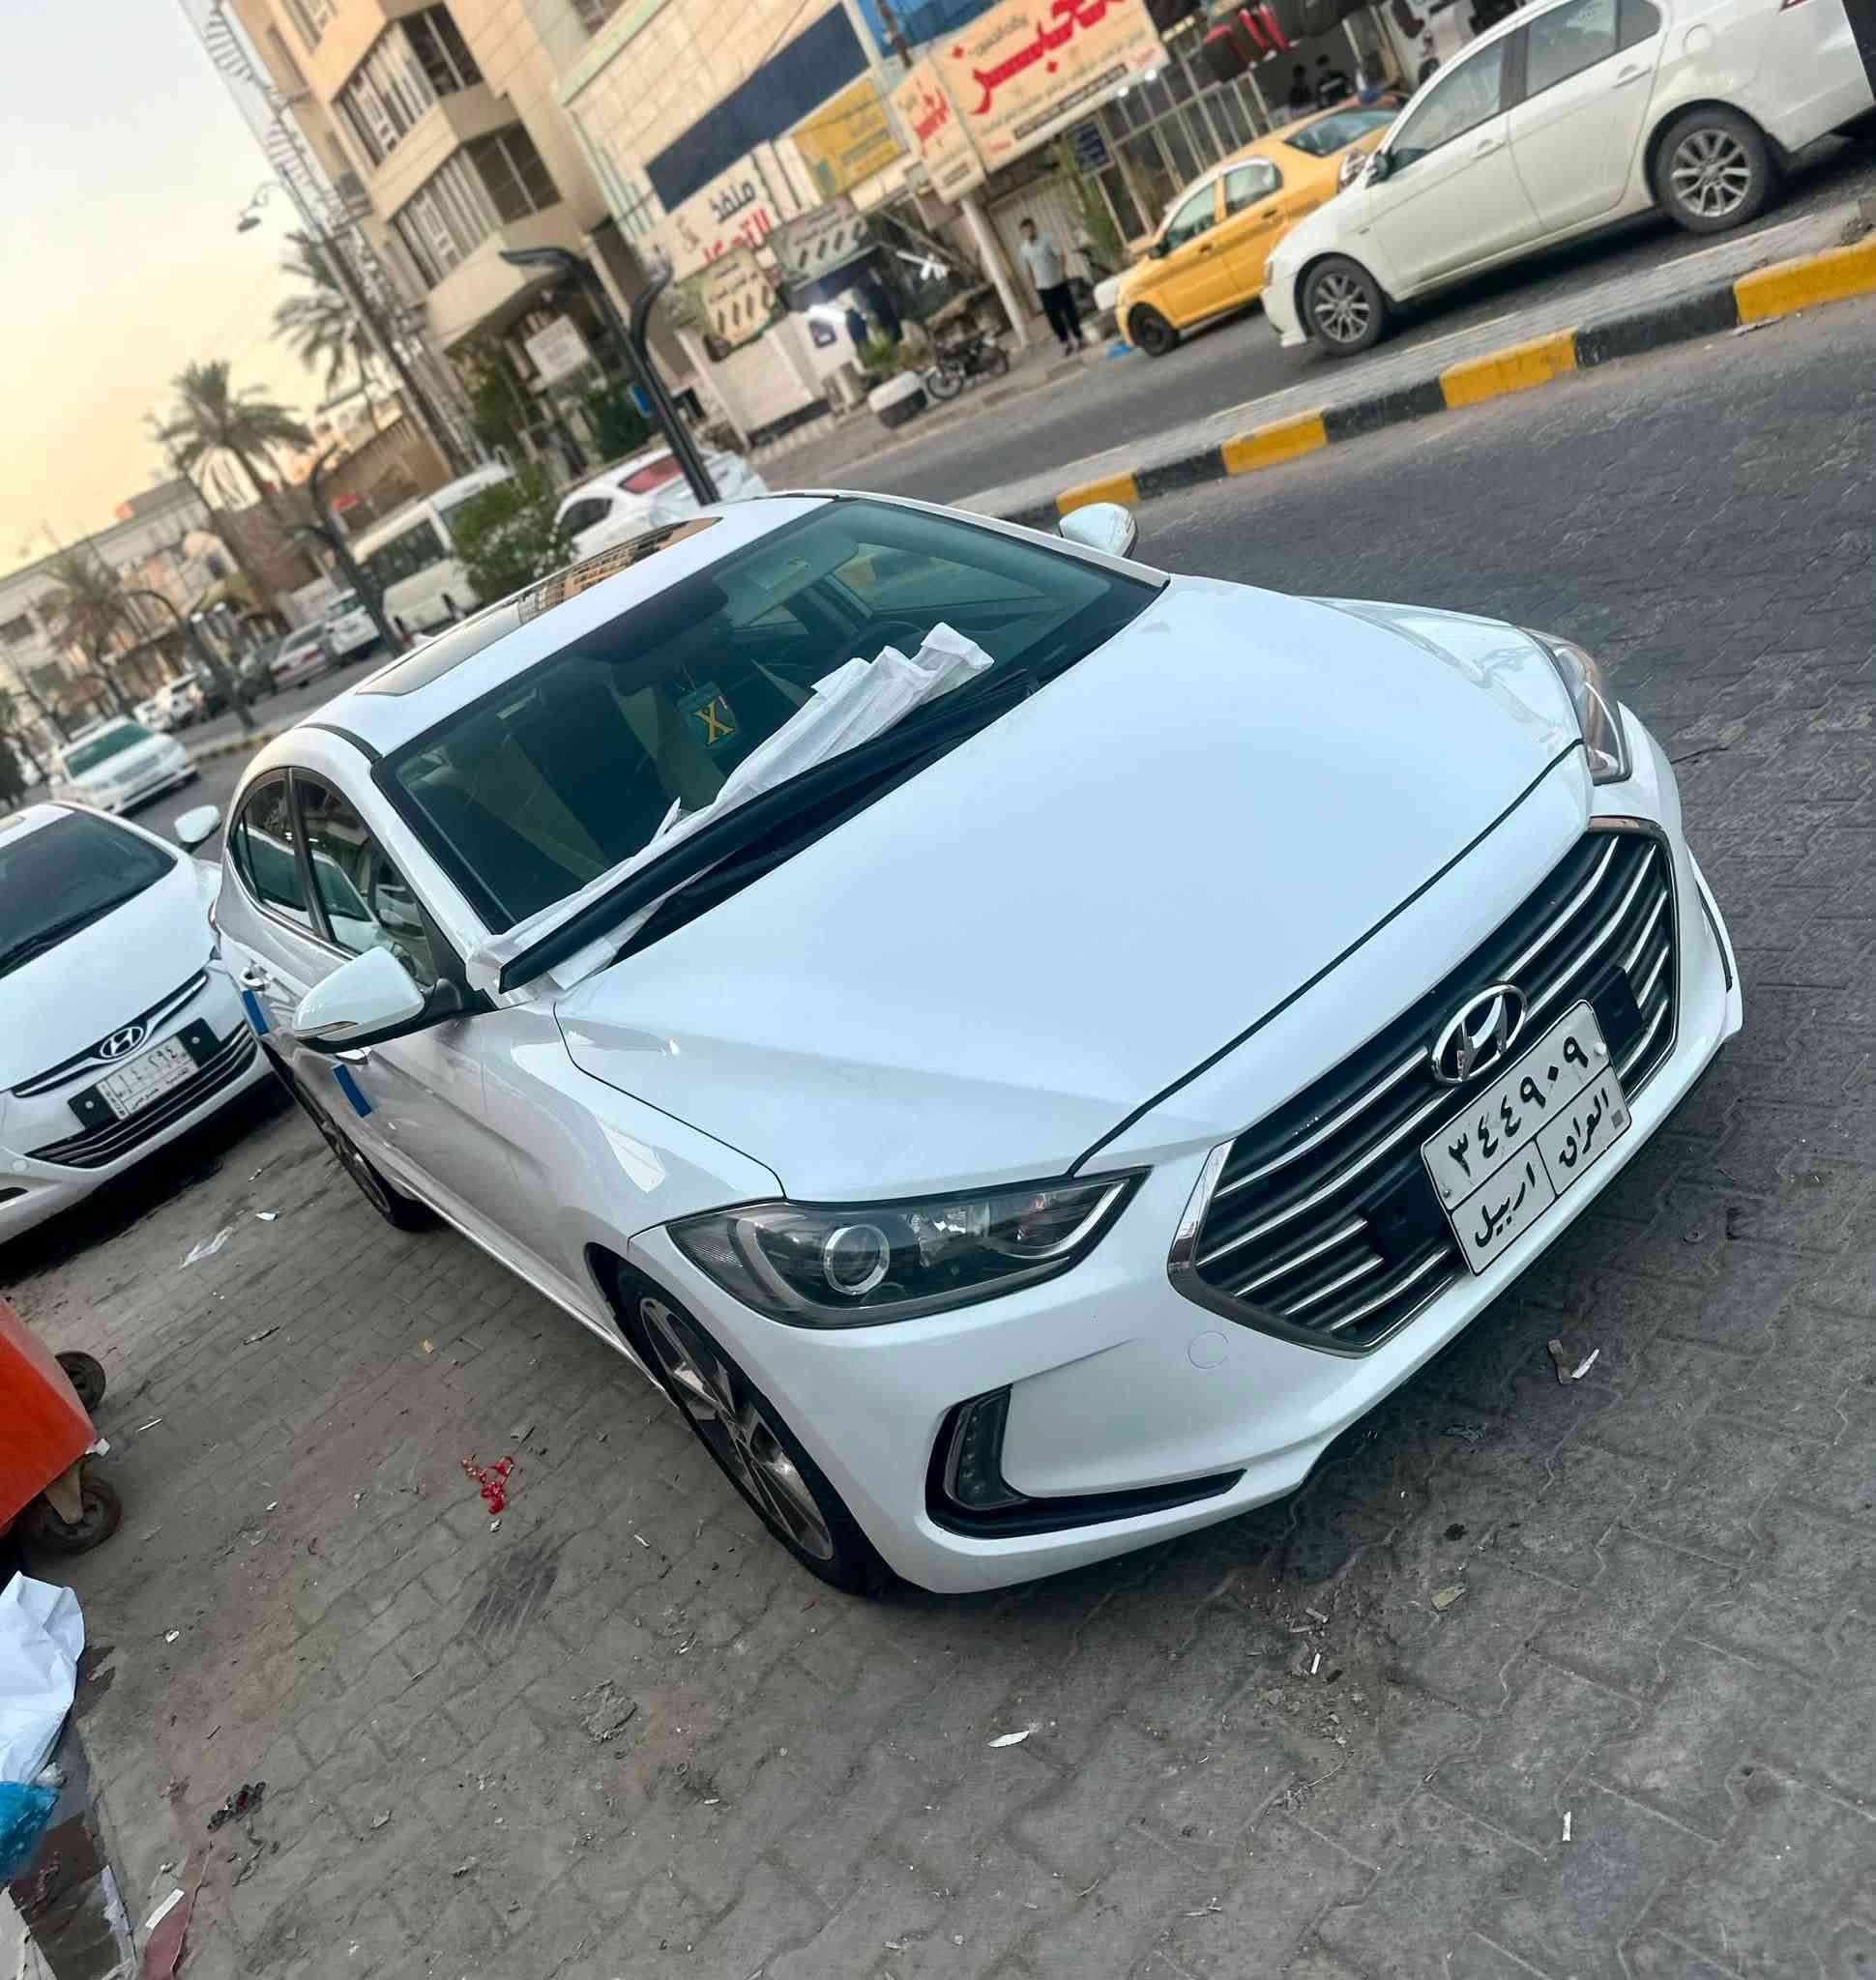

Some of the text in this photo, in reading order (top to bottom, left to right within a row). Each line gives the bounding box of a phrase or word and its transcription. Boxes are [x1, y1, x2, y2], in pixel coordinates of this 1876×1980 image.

[1448, 1034, 1590, 1178] ٣٤٤٩٠٩
[1558, 1088, 1611, 1169] العراق
[1474, 1161, 1536, 1248] اربيل
